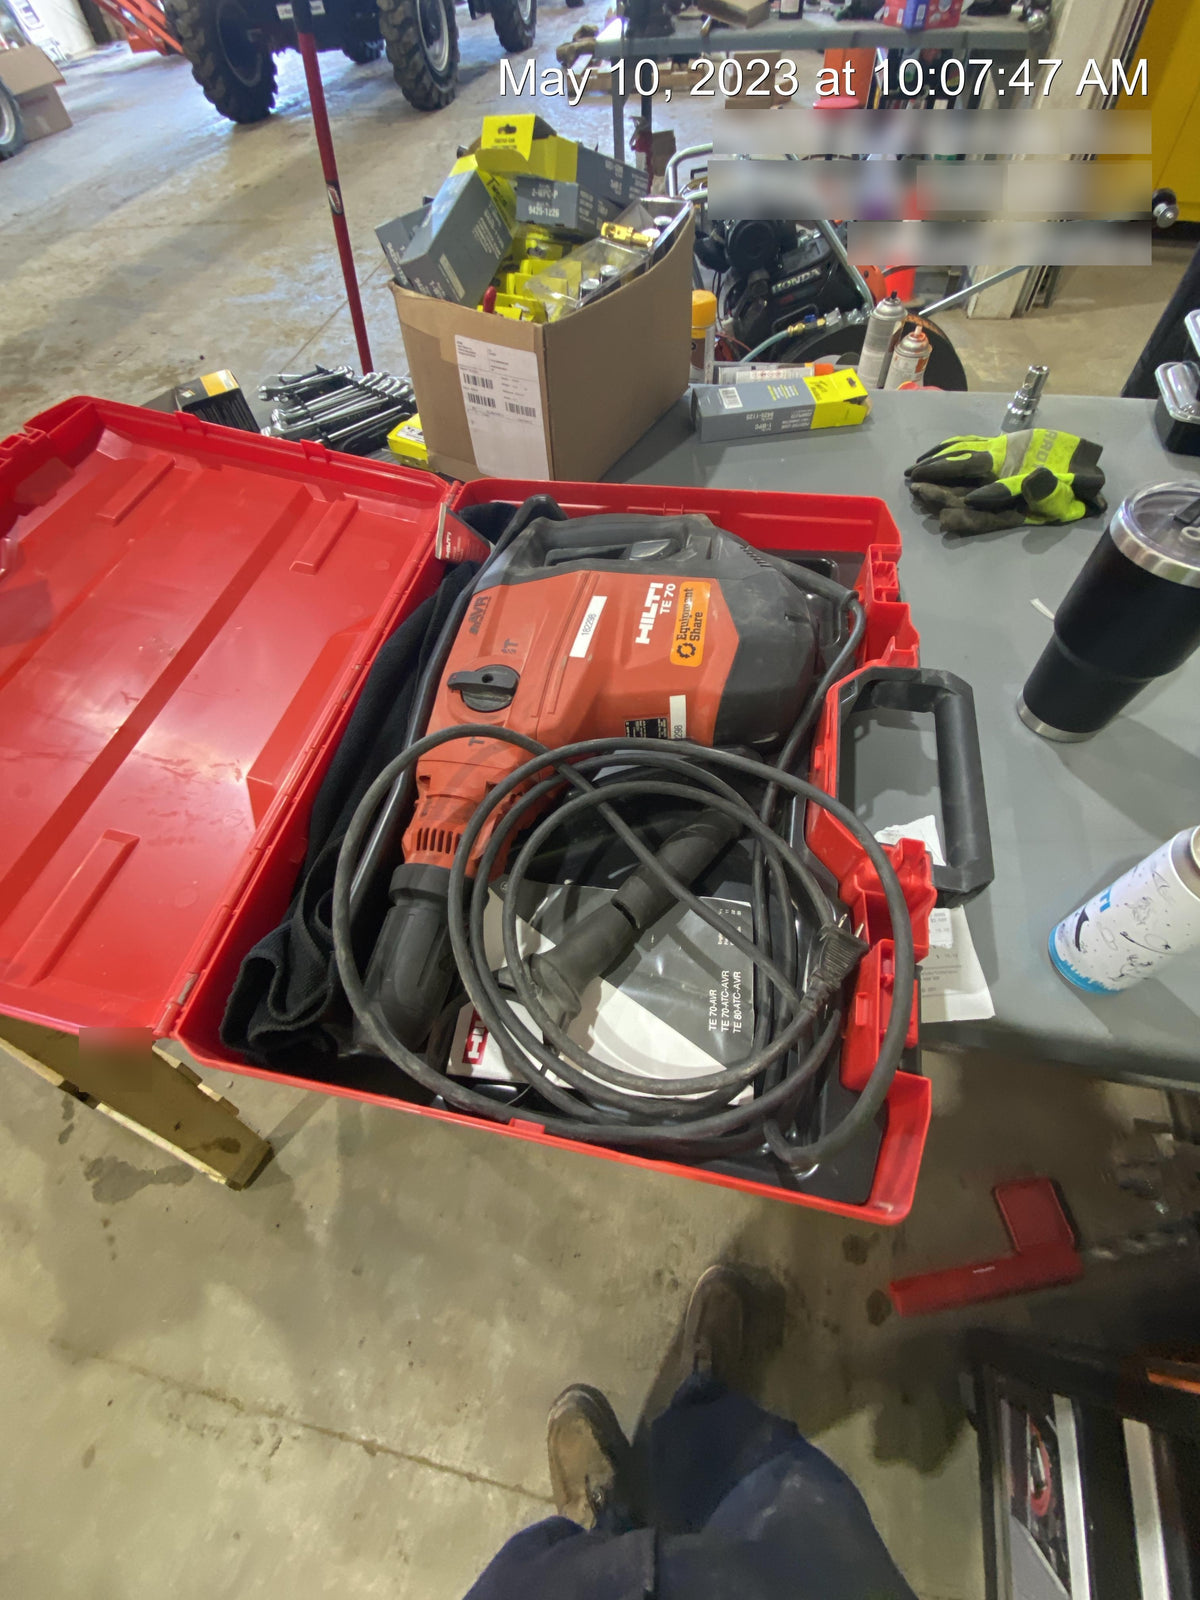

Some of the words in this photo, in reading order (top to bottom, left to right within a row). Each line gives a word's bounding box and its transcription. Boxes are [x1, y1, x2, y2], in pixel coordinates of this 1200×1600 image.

[771, 268, 822, 294] HONDA
[664, 583, 676, 599] 70
[635, 582, 664, 645] HILTI
[660, 600, 672, 614] TE
[676, 587, 694, 641] Equipment
[689, 611, 703, 642] Share
[708, 988, 718, 1016] 70-AVR
[721, 969, 730, 1018] 70-ATC-AVR
[732, 970, 742, 1020] 80-ATC-AVR
[708, 1018, 718, 1032] TE
[720, 1019, 730, 1033] TE
[732, 1021, 742, 1034] TE
